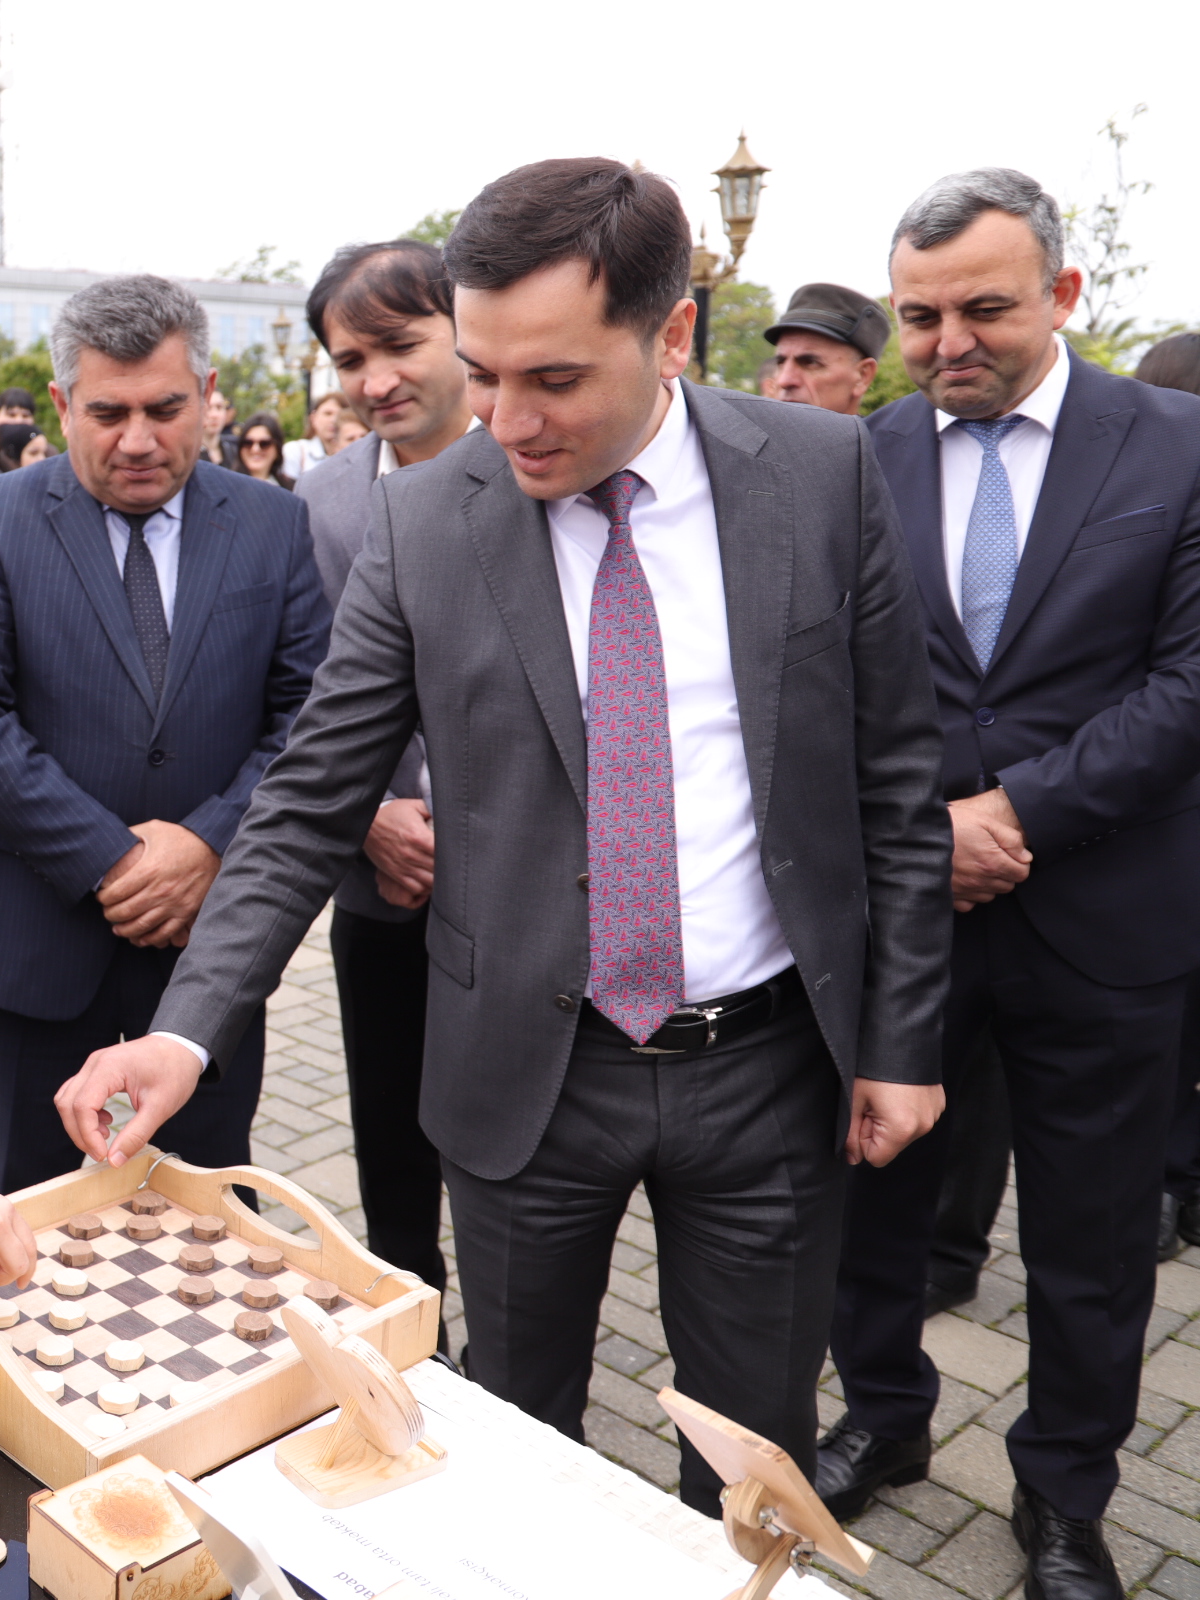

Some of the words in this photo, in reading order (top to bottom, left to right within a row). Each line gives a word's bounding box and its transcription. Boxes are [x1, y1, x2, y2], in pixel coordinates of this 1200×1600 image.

[372, 1546, 401, 1567] orta
[401, 1566, 431, 1588] tam
[456, 1557, 529, 1600] məkçisi
